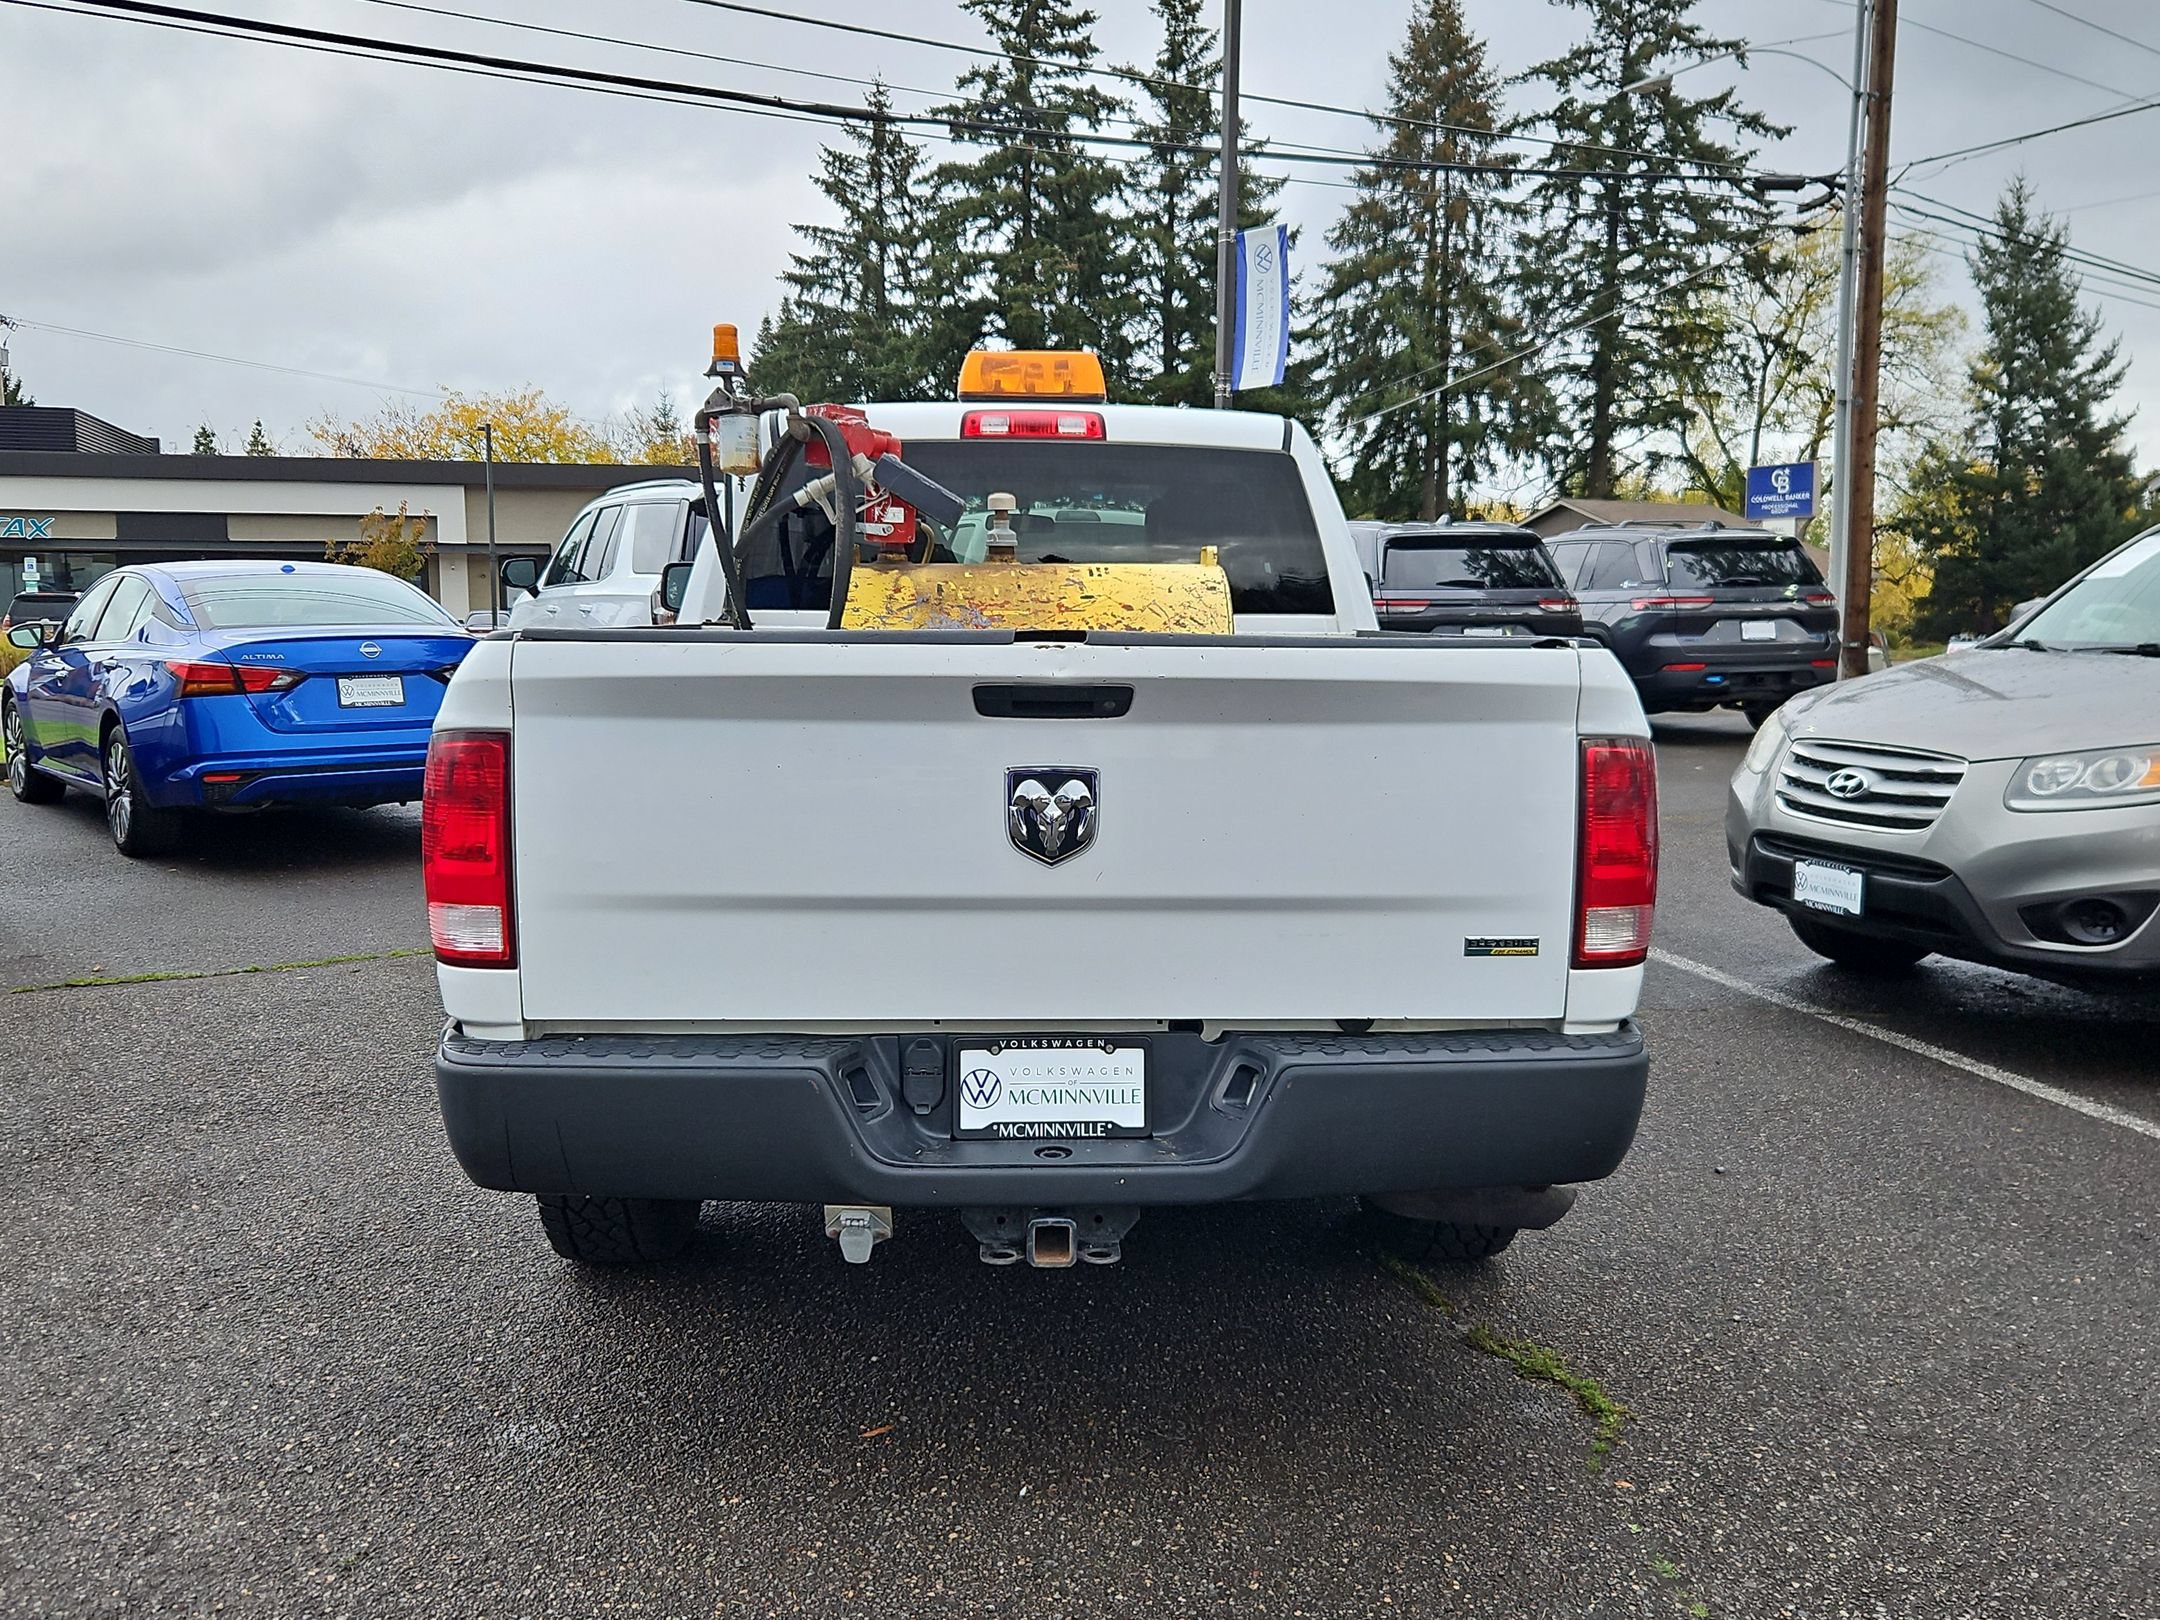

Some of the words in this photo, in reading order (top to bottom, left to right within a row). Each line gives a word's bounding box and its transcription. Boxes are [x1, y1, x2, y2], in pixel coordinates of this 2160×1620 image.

[1251, 279, 1265, 375] MCMINNVILLE
[1750, 494, 1784, 503] COLDWELL
[1785, 492, 1810, 501] BANKER
[999, 1039, 1105, 1048] VOLKSWAGEN
[1009, 1066, 1134, 1076] VOLKSWAGEN
[1008, 1088, 1142, 1105] MCMINNVILLE
[999, 1123, 1106, 1138] MCMINNVILLE
